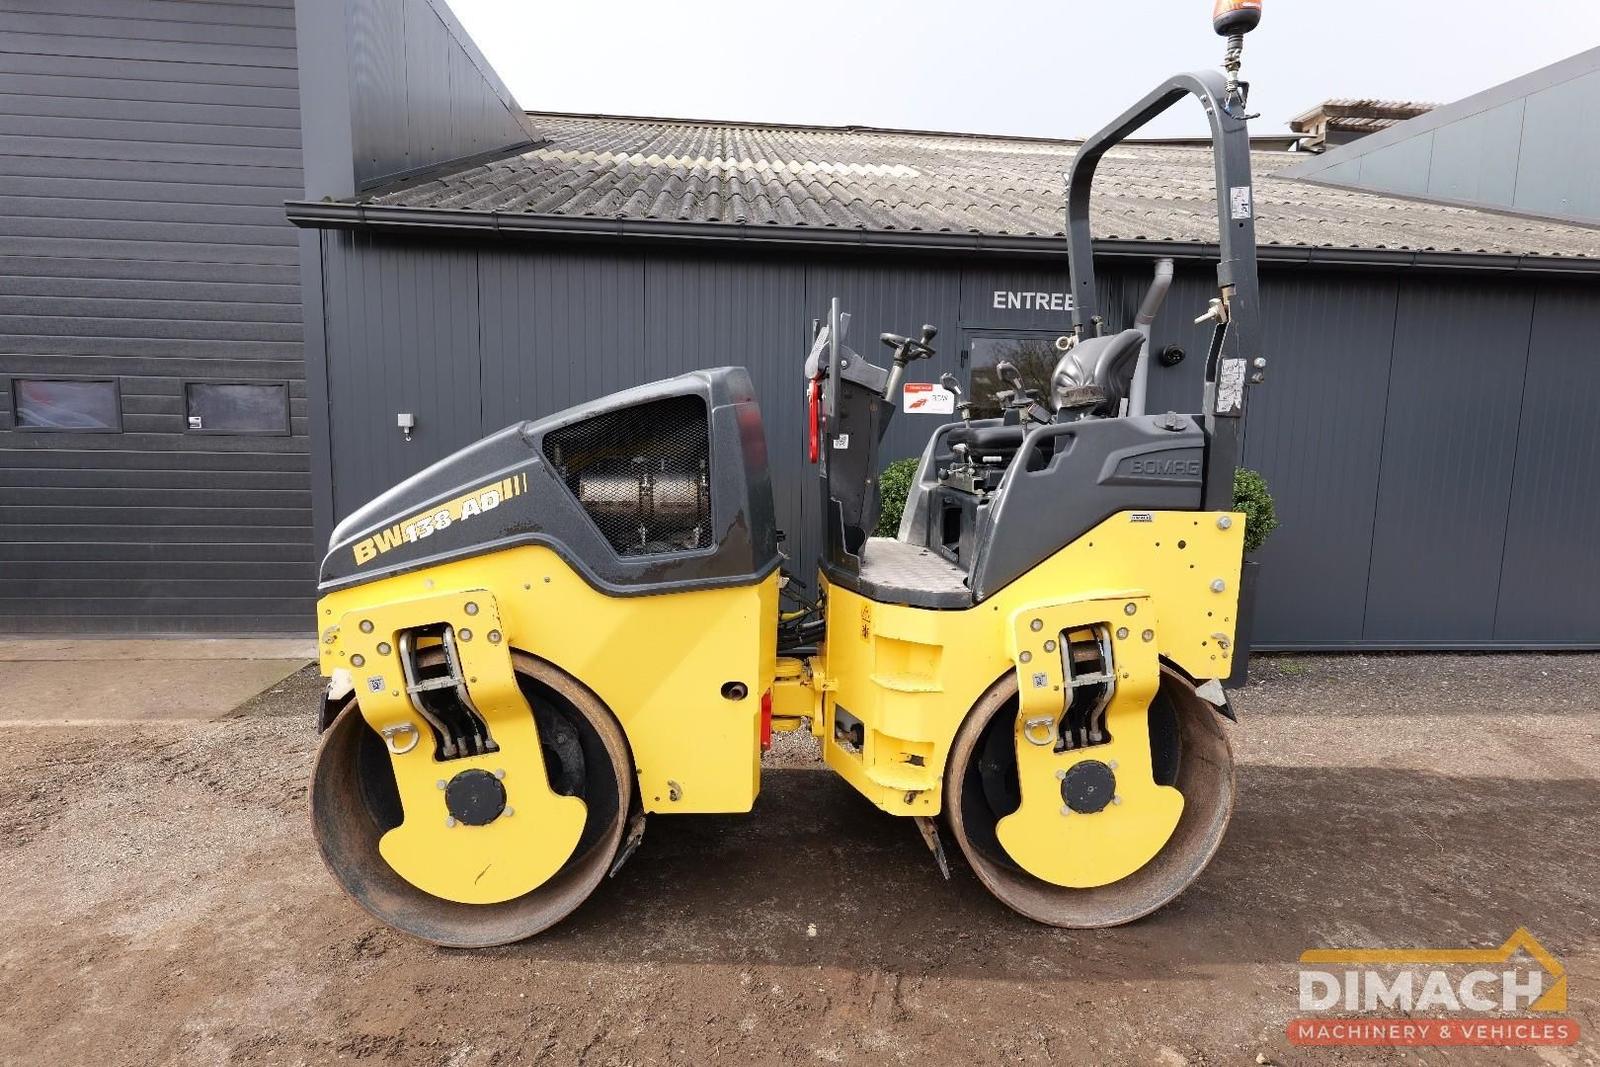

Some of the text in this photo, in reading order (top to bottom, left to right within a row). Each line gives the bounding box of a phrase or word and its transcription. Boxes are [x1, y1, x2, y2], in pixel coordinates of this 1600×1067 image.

[993, 291, 1074, 311] ENTREE
[1132, 460, 1200, 475] BOMAG
[352, 489, 501, 566] BW 138 AD
